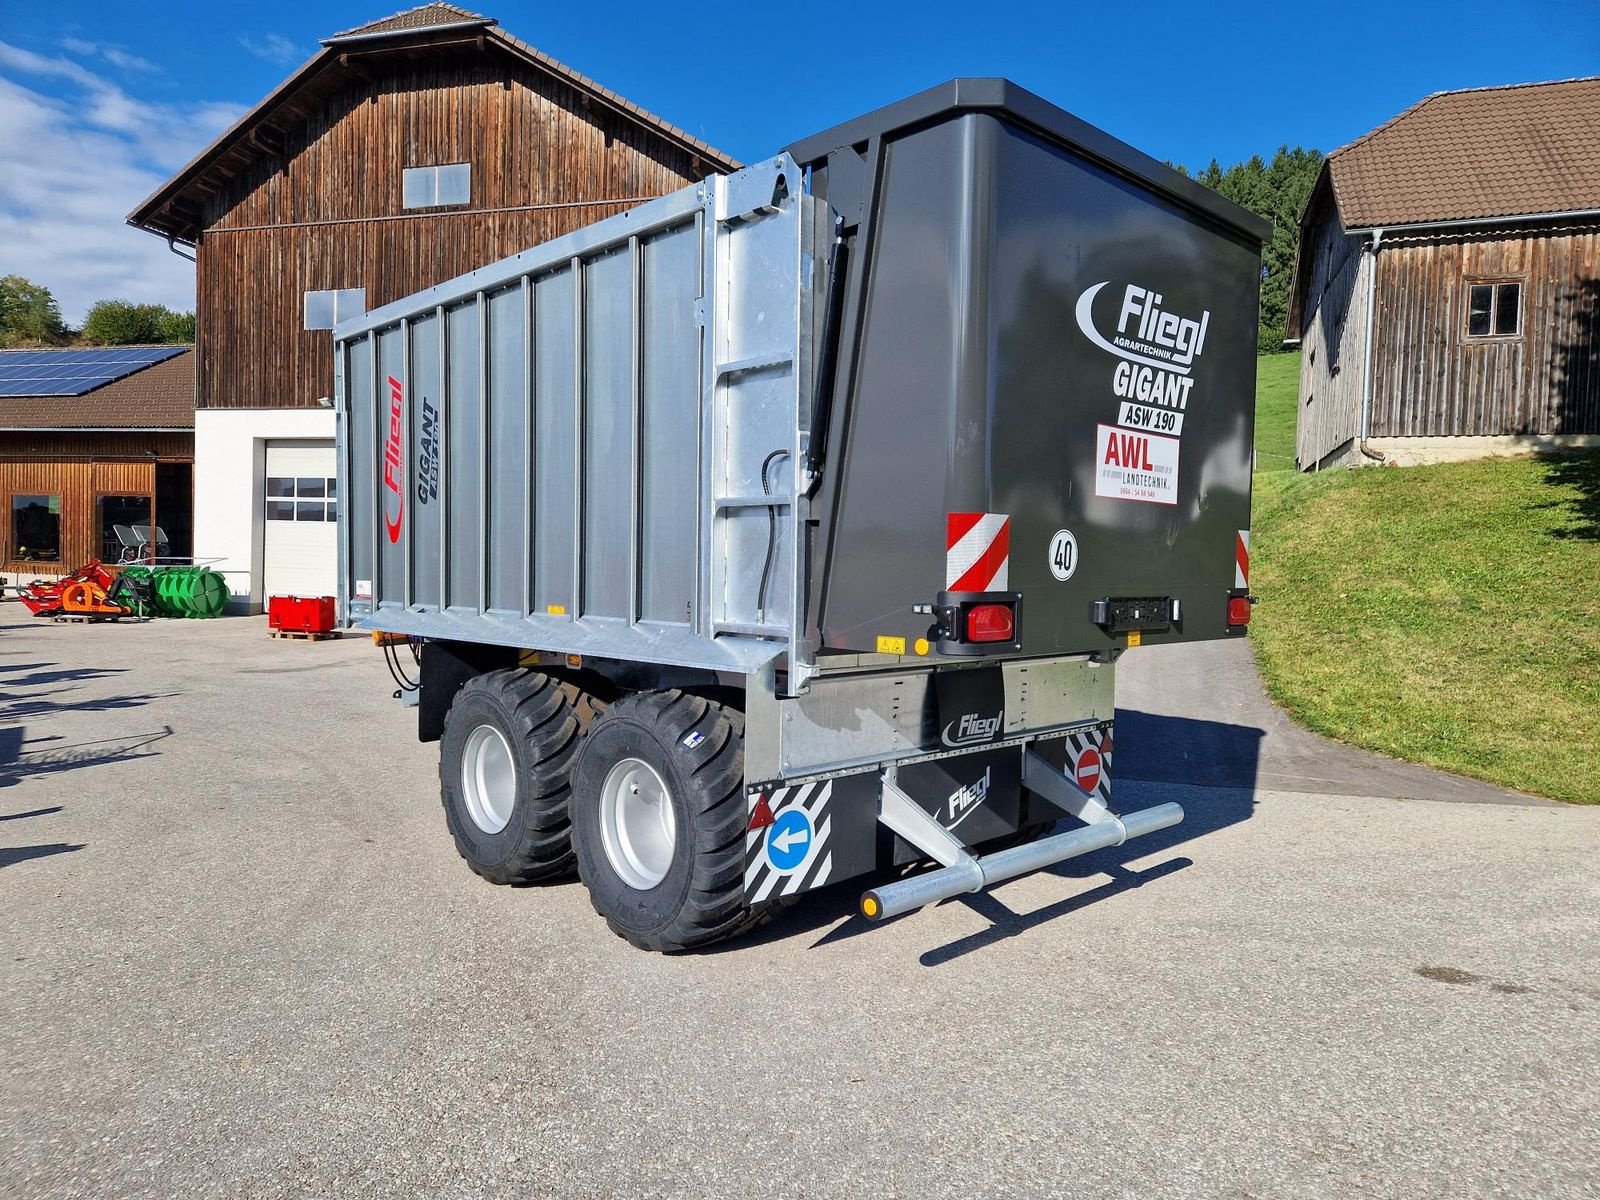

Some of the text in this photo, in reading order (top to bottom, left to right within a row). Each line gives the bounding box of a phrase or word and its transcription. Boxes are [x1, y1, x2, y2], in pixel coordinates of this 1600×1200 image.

[1117, 284, 1210, 365] Fliegl
[1113, 336, 1172, 360] AGRARTECHNIK
[1113, 361, 1194, 410] GIGANT
[1125, 405, 1175, 431] ASW 190
[418, 396, 434, 505] GIGANT
[1104, 432, 1153, 471] AWL
[1054, 539, 1072, 571] 40
[958, 710, 1004, 738] Fliegl
[948, 765, 990, 820] Fliegl
